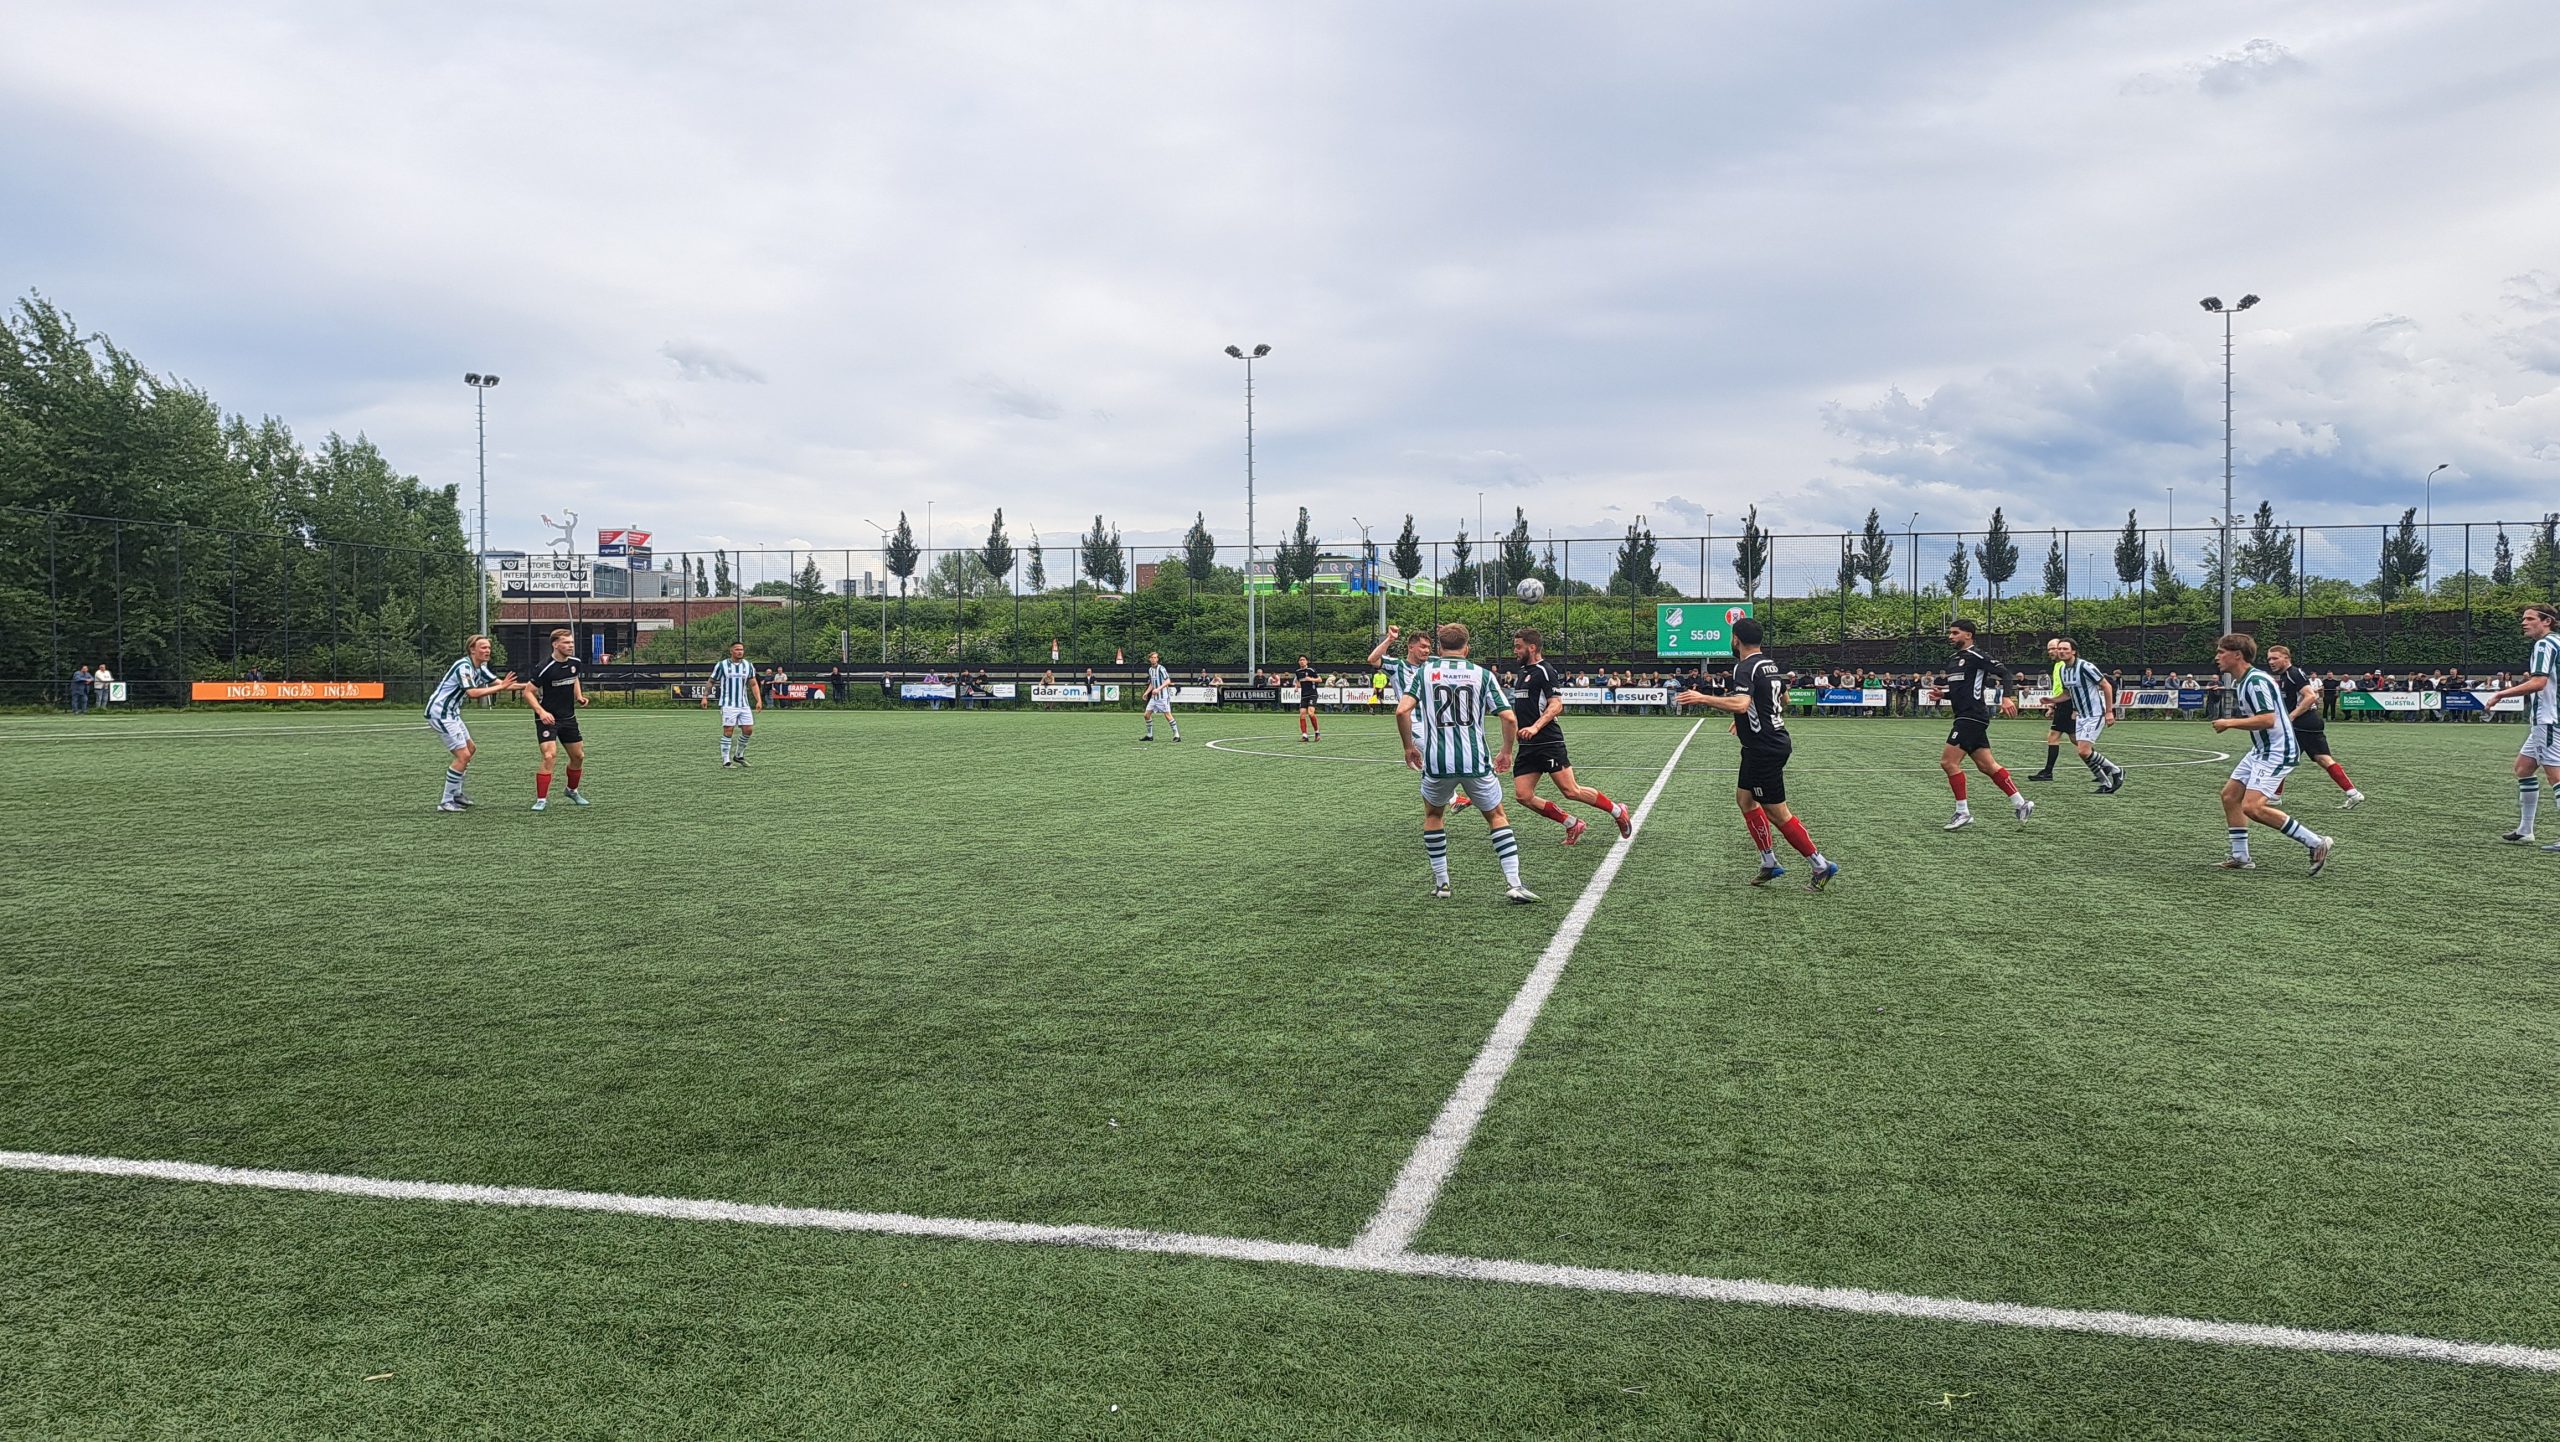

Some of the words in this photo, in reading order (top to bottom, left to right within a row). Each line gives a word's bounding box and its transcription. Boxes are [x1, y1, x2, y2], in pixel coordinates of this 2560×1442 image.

[1690, 630, 1721, 641] 55:09
[1668, 635, 1678, 648] 2
[227, 686, 251, 697] ING
[277, 686, 300, 697] ING
[323, 685, 346, 697] ING
[691, 686, 717, 695] SEDC
[1032, 687, 1089, 696] daar-om.n
[1604, 691, 1664, 701] Bessure?
[2120, 691, 2134, 705] IB
[2138, 694, 2169, 705] NOORD
[1434, 685, 1475, 728] 20
[1548, 759, 1555, 768] 7
[2257, 768, 2265, 777] 15
[1753, 786, 1764, 797] 10
